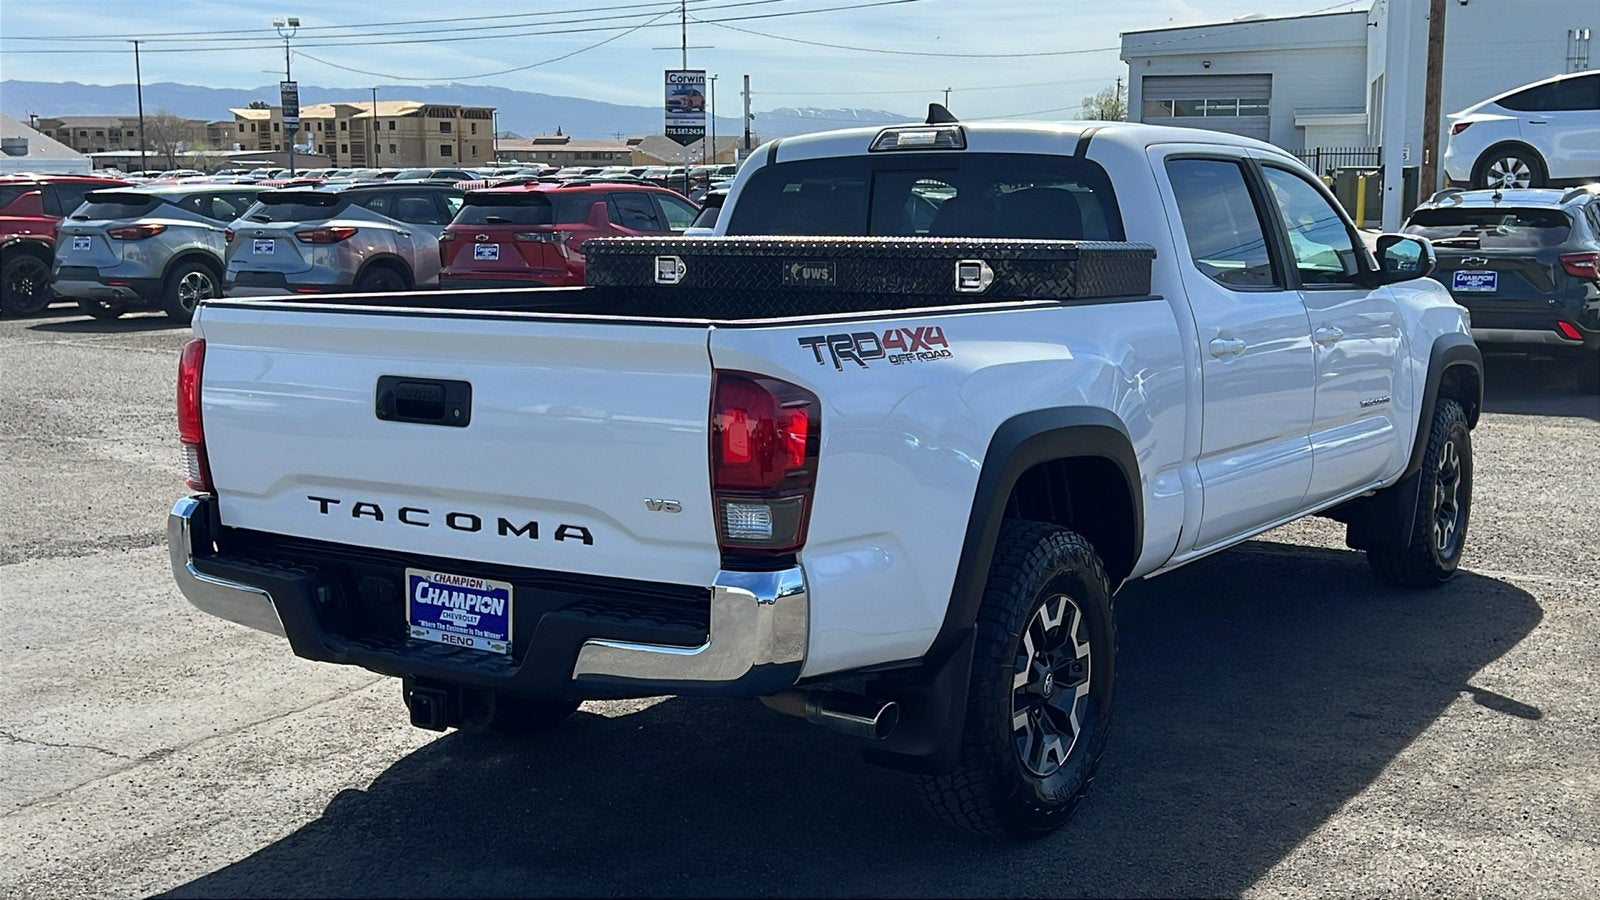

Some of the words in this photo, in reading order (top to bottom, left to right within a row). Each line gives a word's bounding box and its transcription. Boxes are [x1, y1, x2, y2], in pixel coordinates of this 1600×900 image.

[669, 74, 705, 83] Corwin
[802, 268, 829, 280] UWS
[1456, 273, 1494, 281] CHAMPION
[797, 331, 886, 372] TRD
[888, 352, 917, 366] OFF
[916, 349, 953, 363] ROAD
[644, 498, 682, 513] V6
[307, 495, 594, 546] TACOMA
[434, 573, 483, 588] CHAMPION
[415, 581, 505, 616] CHAMPION
[442, 611, 478, 624] CHEVROLET
[437, 622, 445, 630] The
[474, 628, 483, 637] The
[441, 633, 474, 647] RENO
